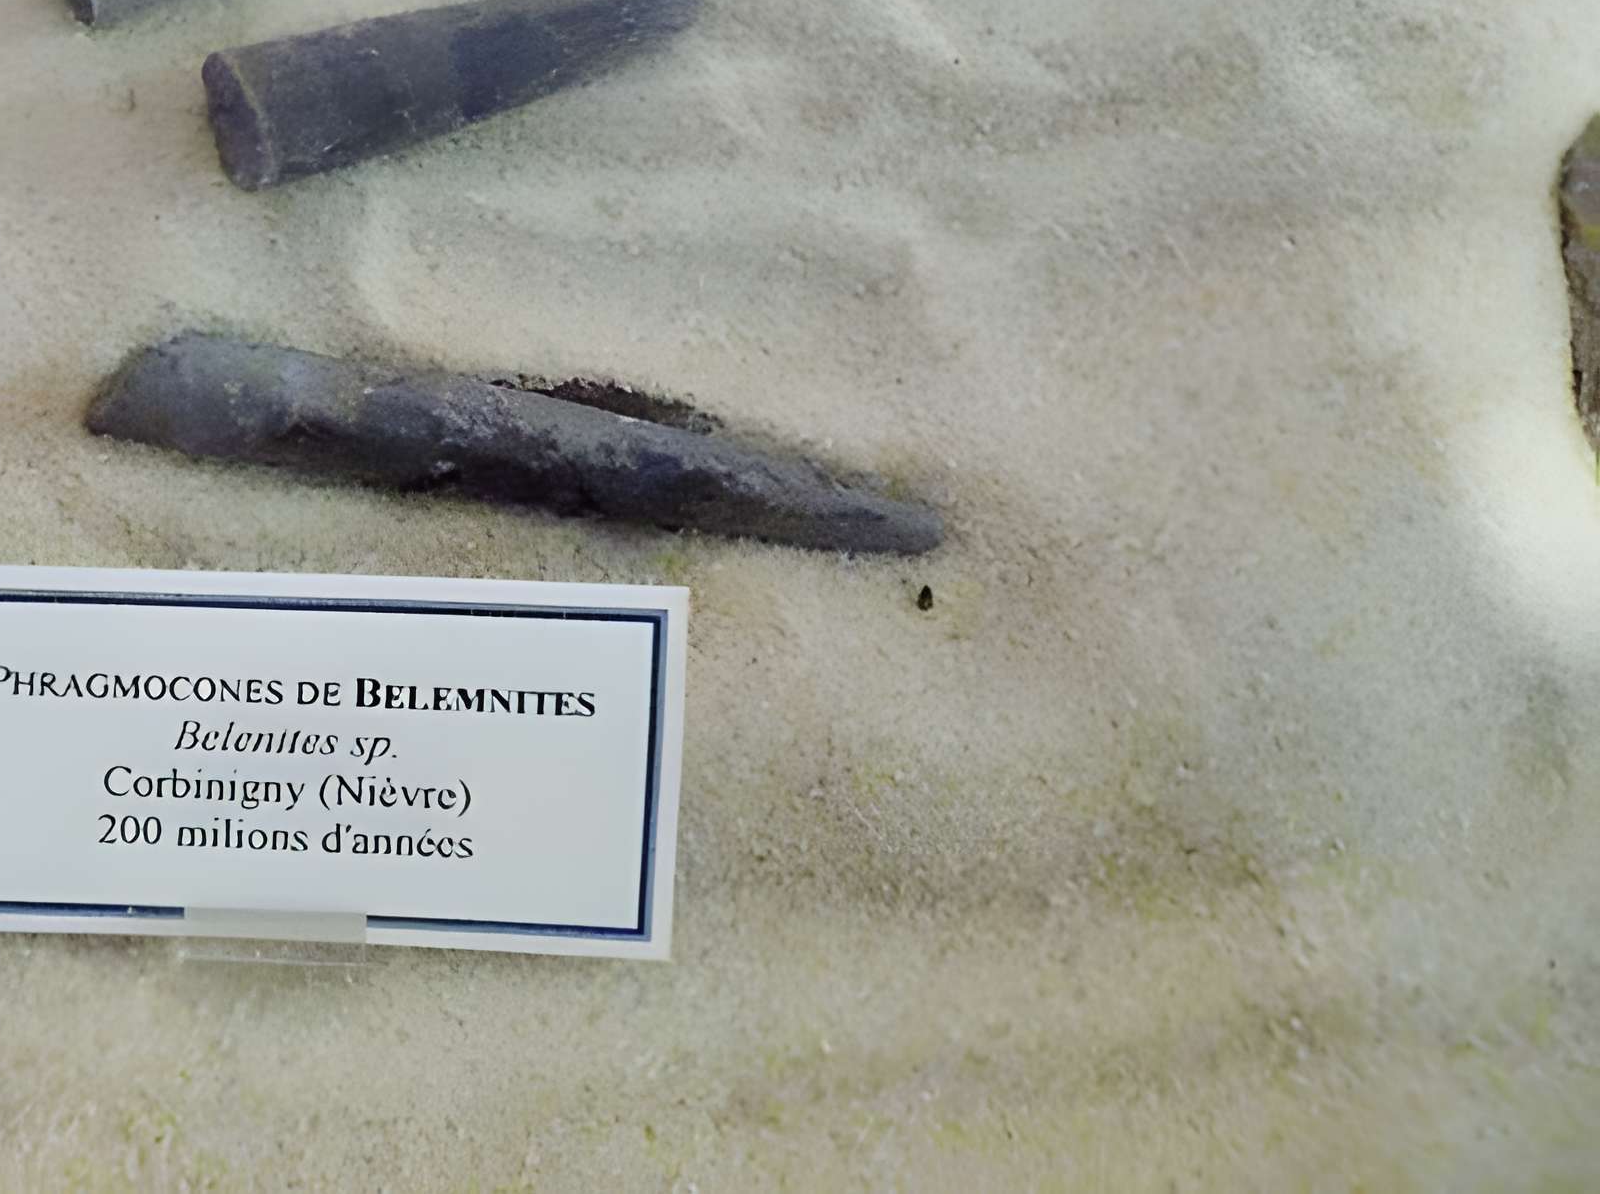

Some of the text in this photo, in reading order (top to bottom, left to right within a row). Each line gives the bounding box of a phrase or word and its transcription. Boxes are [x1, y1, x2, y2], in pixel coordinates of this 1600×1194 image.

[297, 682, 340, 706] DE
[356, 678, 595, 717] BELEMNITES
[349, 736, 397, 766] sp.
[104, 766, 471, 817] Corbinigny (Nièvre)
[98, 814, 473, 858] 200 milions d'années
